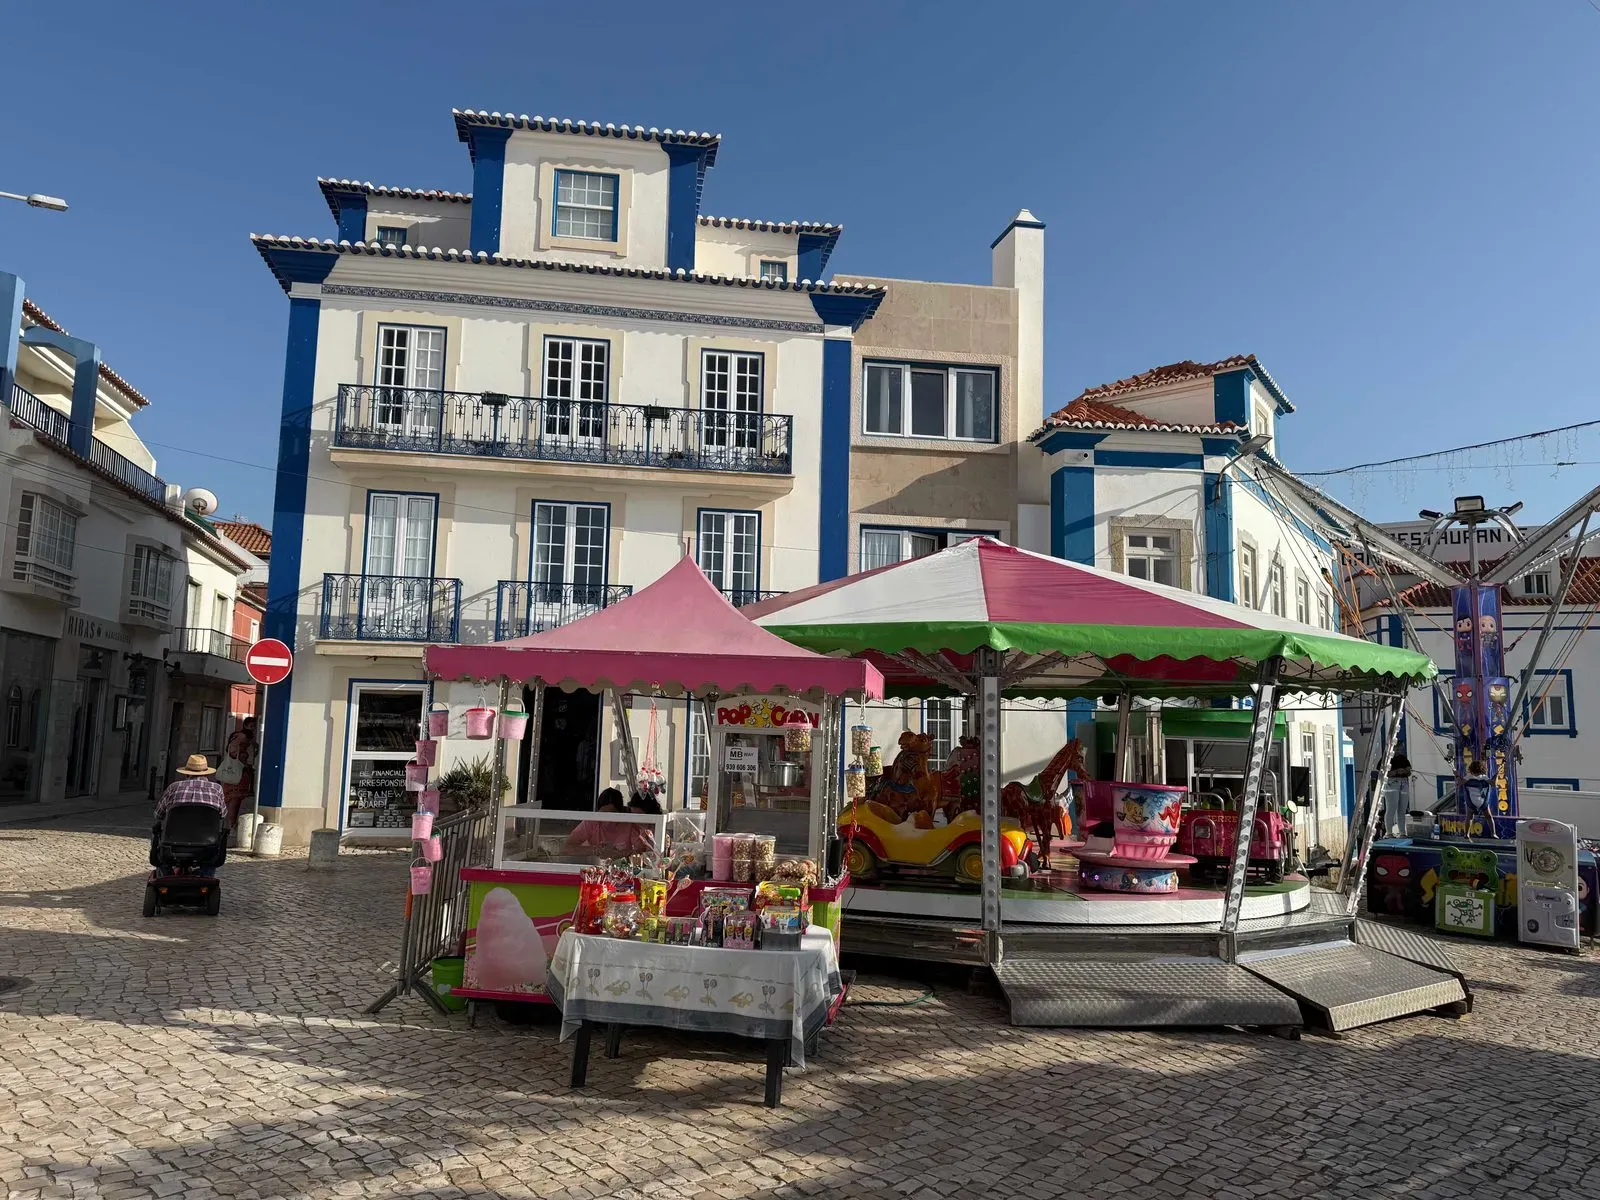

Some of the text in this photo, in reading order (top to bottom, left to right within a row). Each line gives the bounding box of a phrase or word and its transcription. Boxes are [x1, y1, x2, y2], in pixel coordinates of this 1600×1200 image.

[68, 615, 96, 639] RIBAS
[717, 705, 820, 728] POP CORN
[371, 769, 406, 777] FINANCIALL
[359, 779, 406, 787] IRRESPONSIB
[381, 790, 404, 798] NEW
